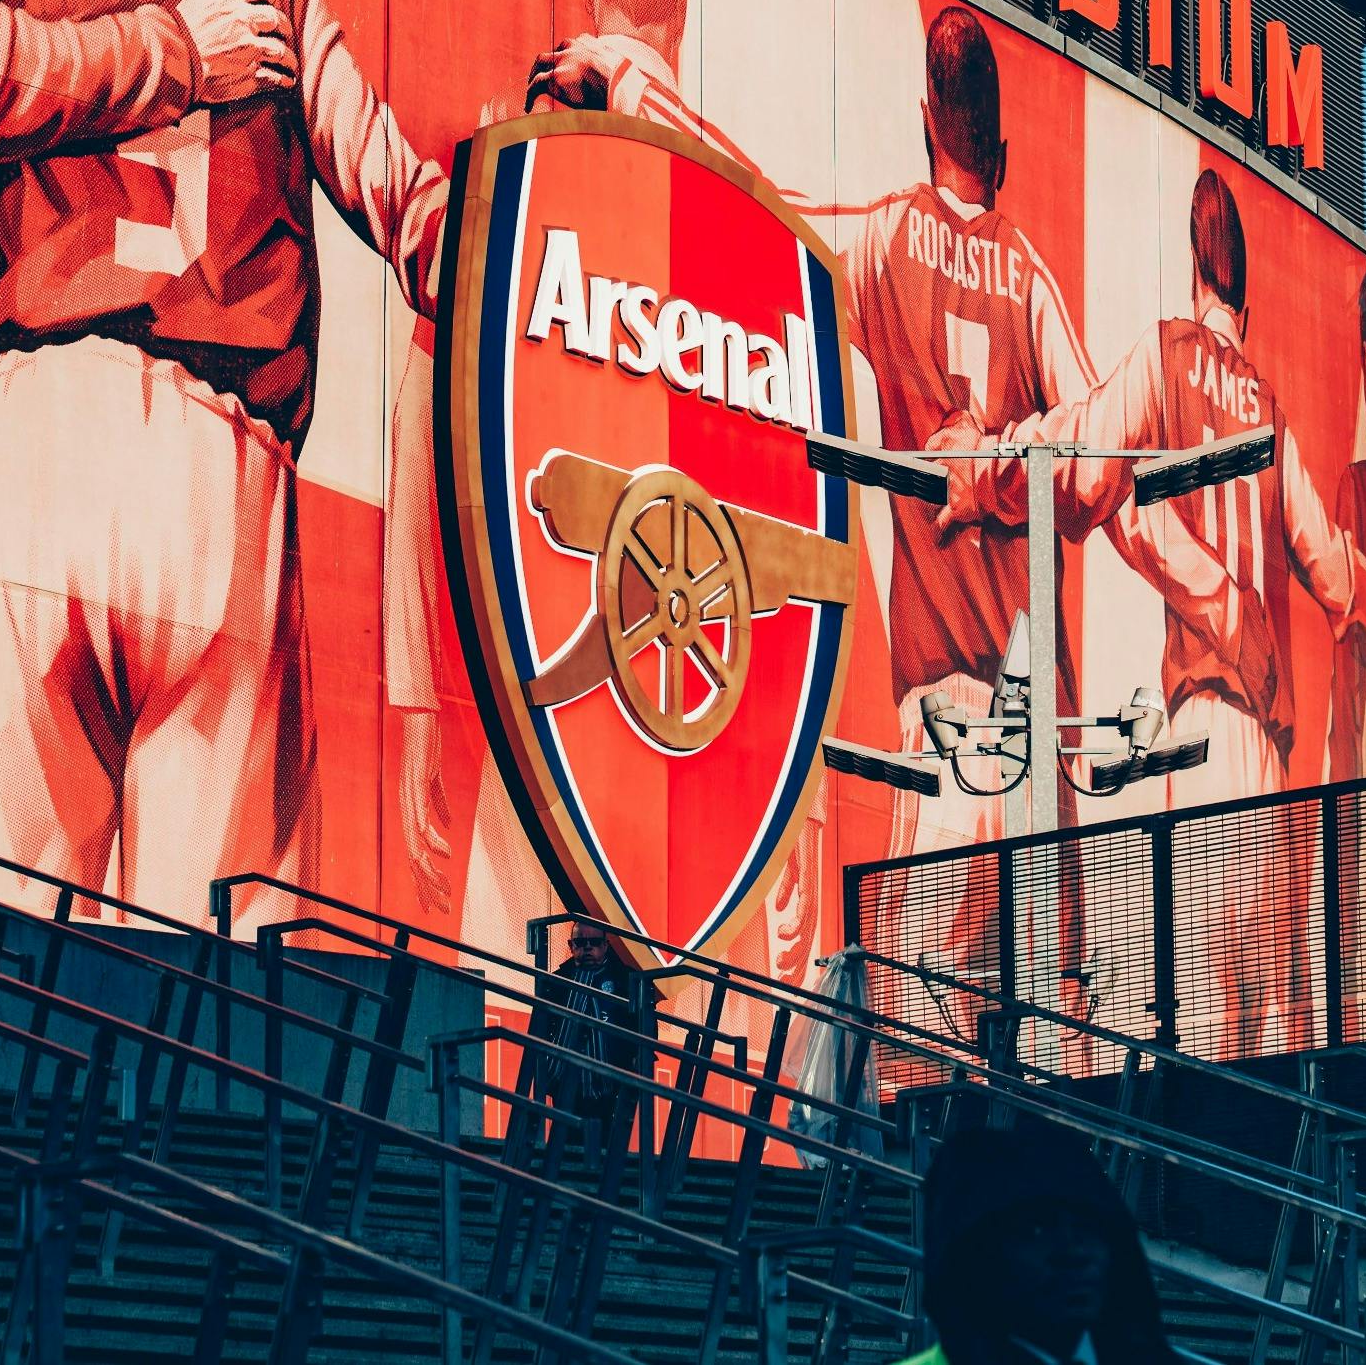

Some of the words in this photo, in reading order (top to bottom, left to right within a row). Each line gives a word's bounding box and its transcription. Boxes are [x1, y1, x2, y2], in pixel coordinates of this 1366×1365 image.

[907, 208, 1023, 305] ROCASTLE
[526, 229, 815, 434] Arsenal
[1187, 344, 1261, 425] JAMES
